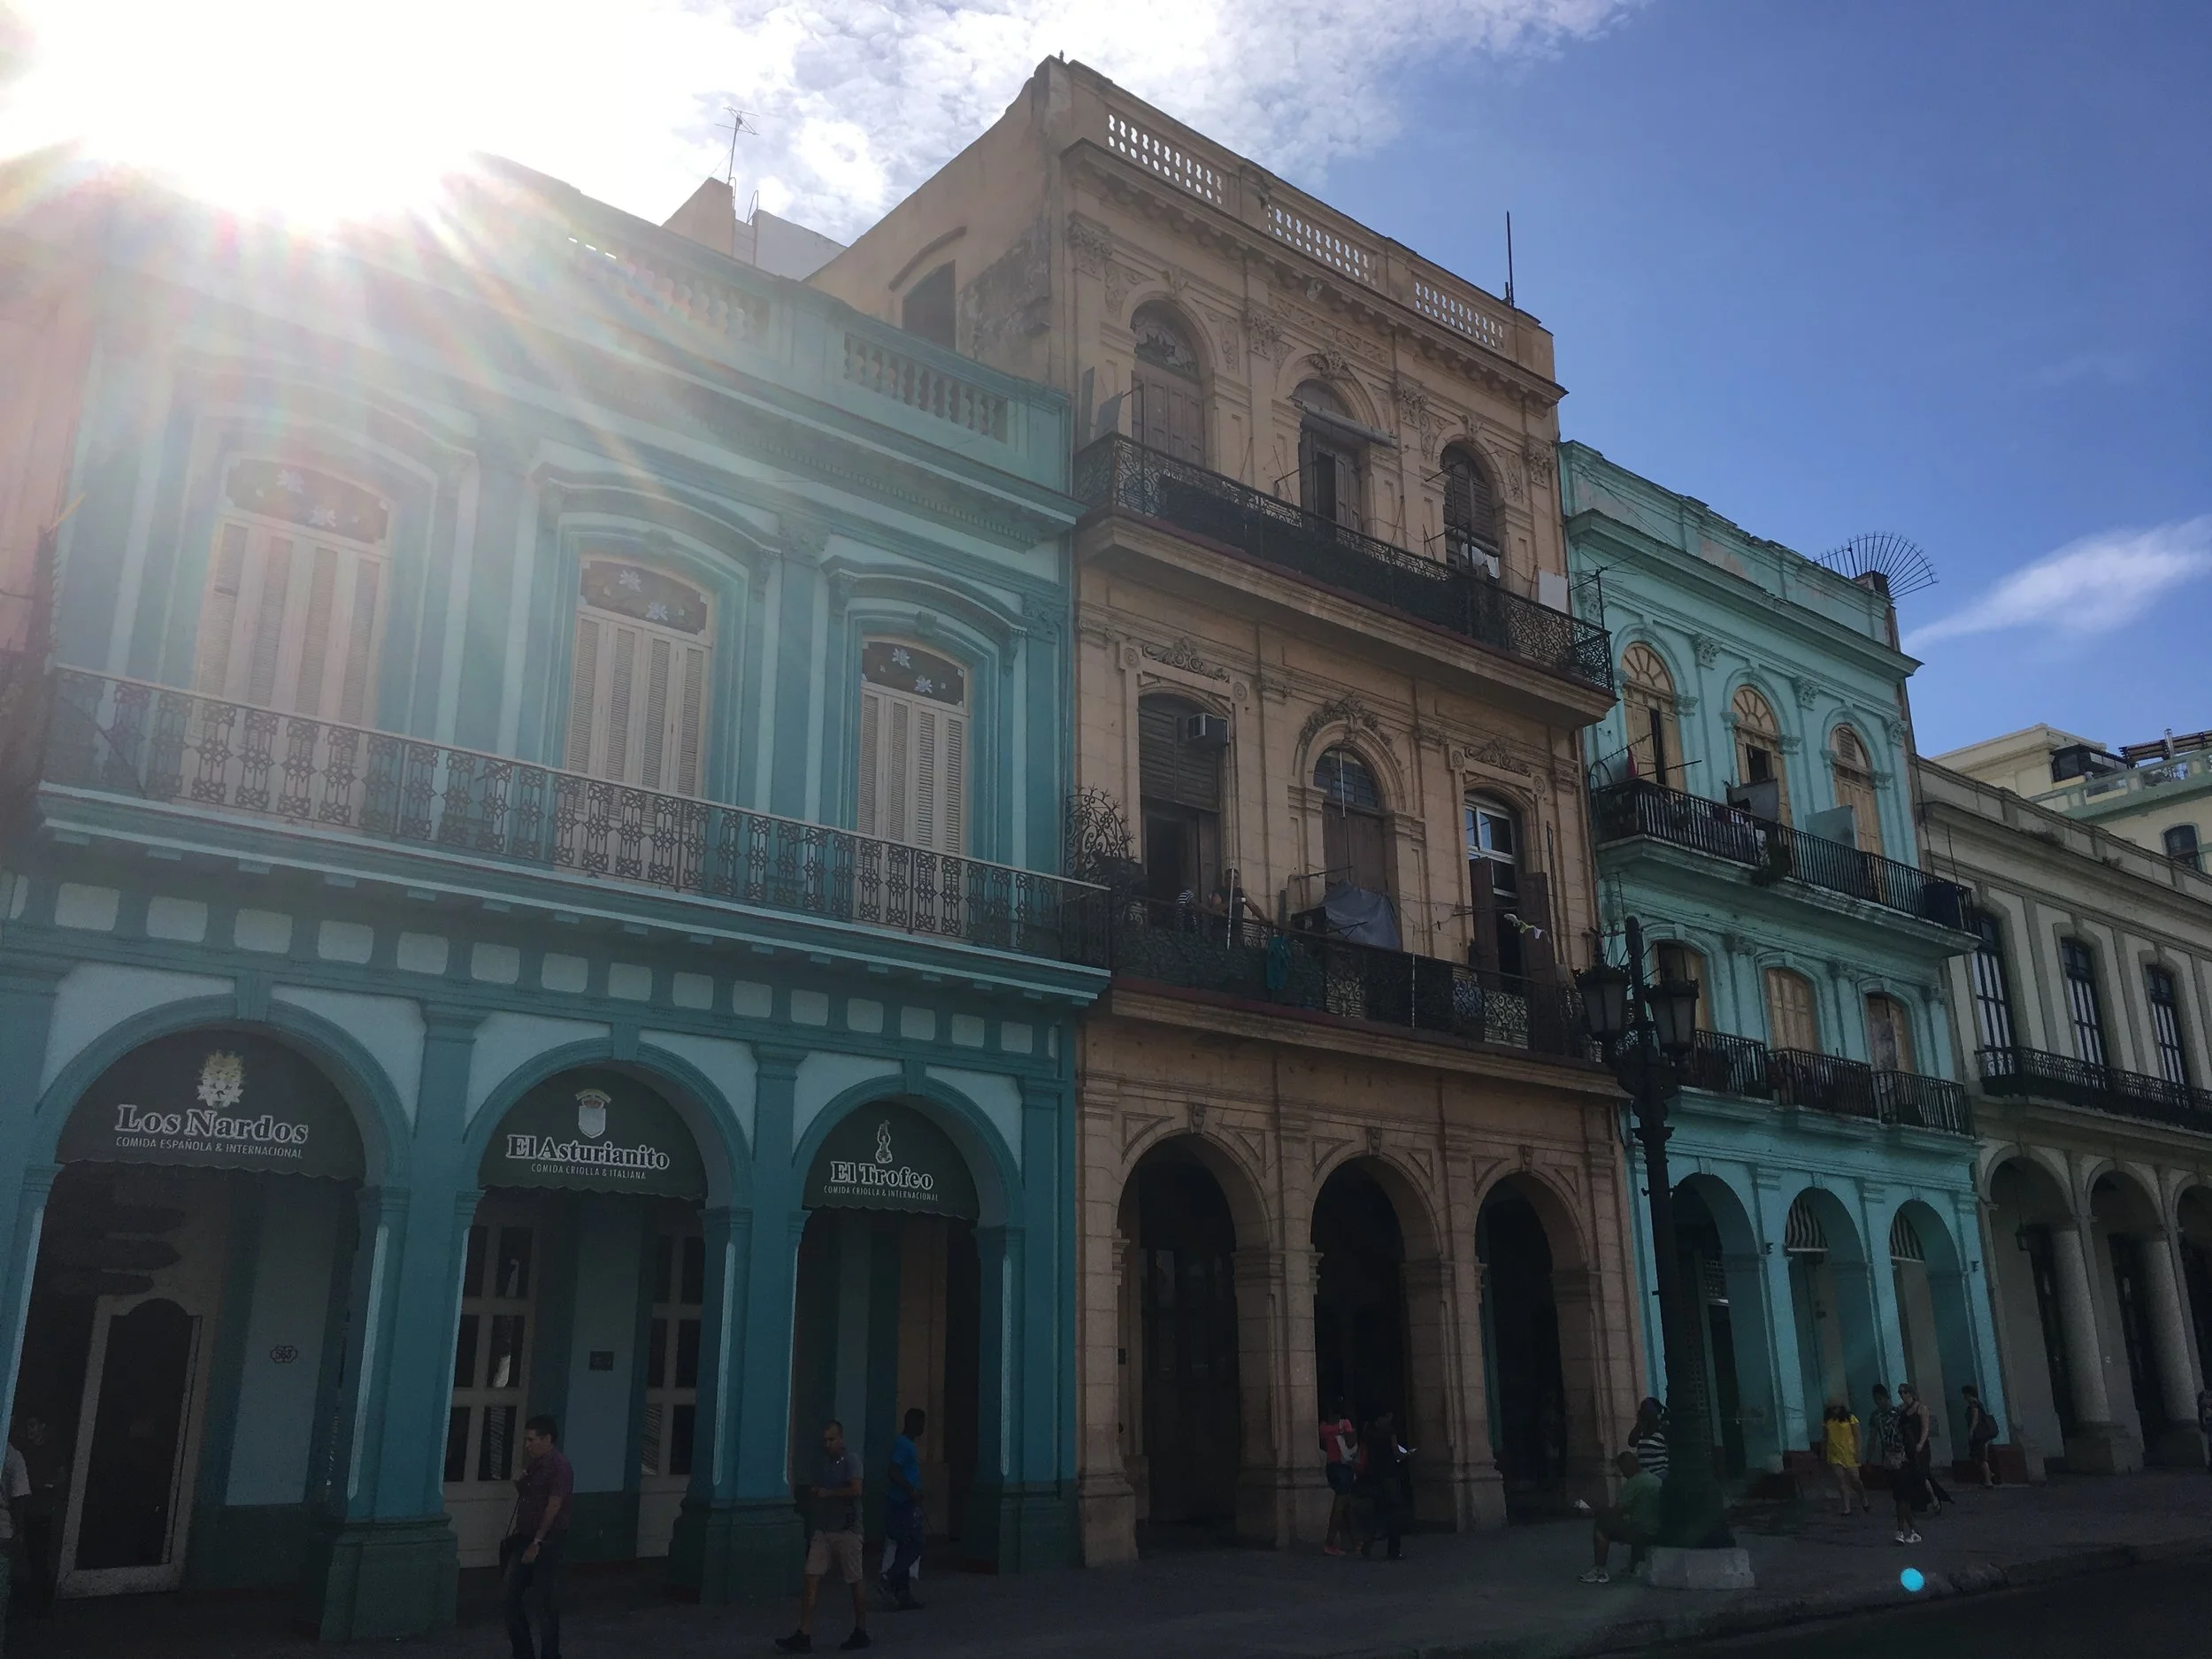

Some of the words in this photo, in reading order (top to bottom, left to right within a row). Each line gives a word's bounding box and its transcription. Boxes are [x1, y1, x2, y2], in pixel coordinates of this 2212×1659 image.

[115, 1103, 180, 1134] Los
[186, 1109, 309, 1144] Nardos
[116, 1136, 157, 1148] COMIDA
[160, 1138, 212, 1152] ESPAÑOLA
[215, 1142, 222, 1151] &
[226, 1143, 303, 1159] INTERNACIONAL
[505, 1133, 537, 1159] El
[538, 1136, 671, 1171] Asturianito
[531, 1163, 564, 1174] COMIDA
[565, 1165, 600, 1176] CRIOLLA
[610, 1169, 647, 1180] ITALIANA
[830, 1161, 857, 1184] El
[859, 1163, 933, 1190] Trofeo
[824, 1185, 850, 1194] COMIDA
[852, 1187, 879, 1196] CRIOLLA
[888, 1189, 939, 1202] INTERNACIONAL
